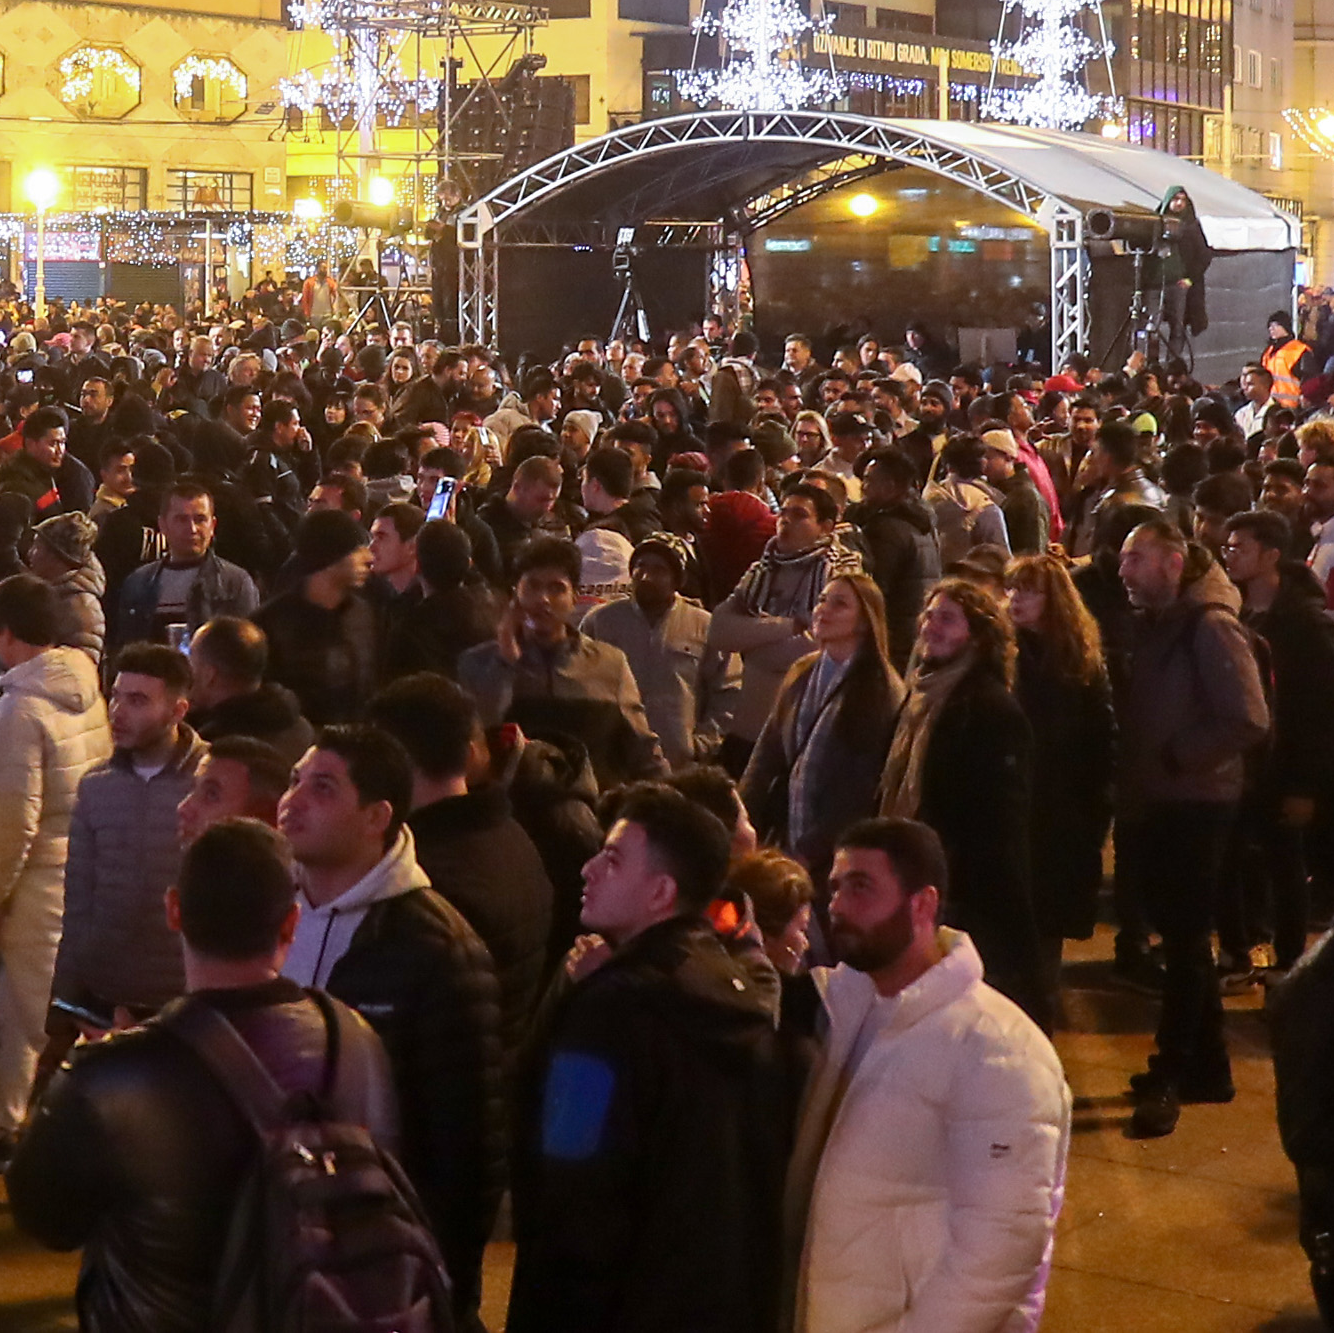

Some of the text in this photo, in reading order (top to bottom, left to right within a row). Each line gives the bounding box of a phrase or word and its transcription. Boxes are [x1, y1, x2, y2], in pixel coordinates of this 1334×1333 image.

[858, 37, 865, 58] U
[867, 39, 895, 61] RITMU
[897, 42, 930, 65] GRADA.
